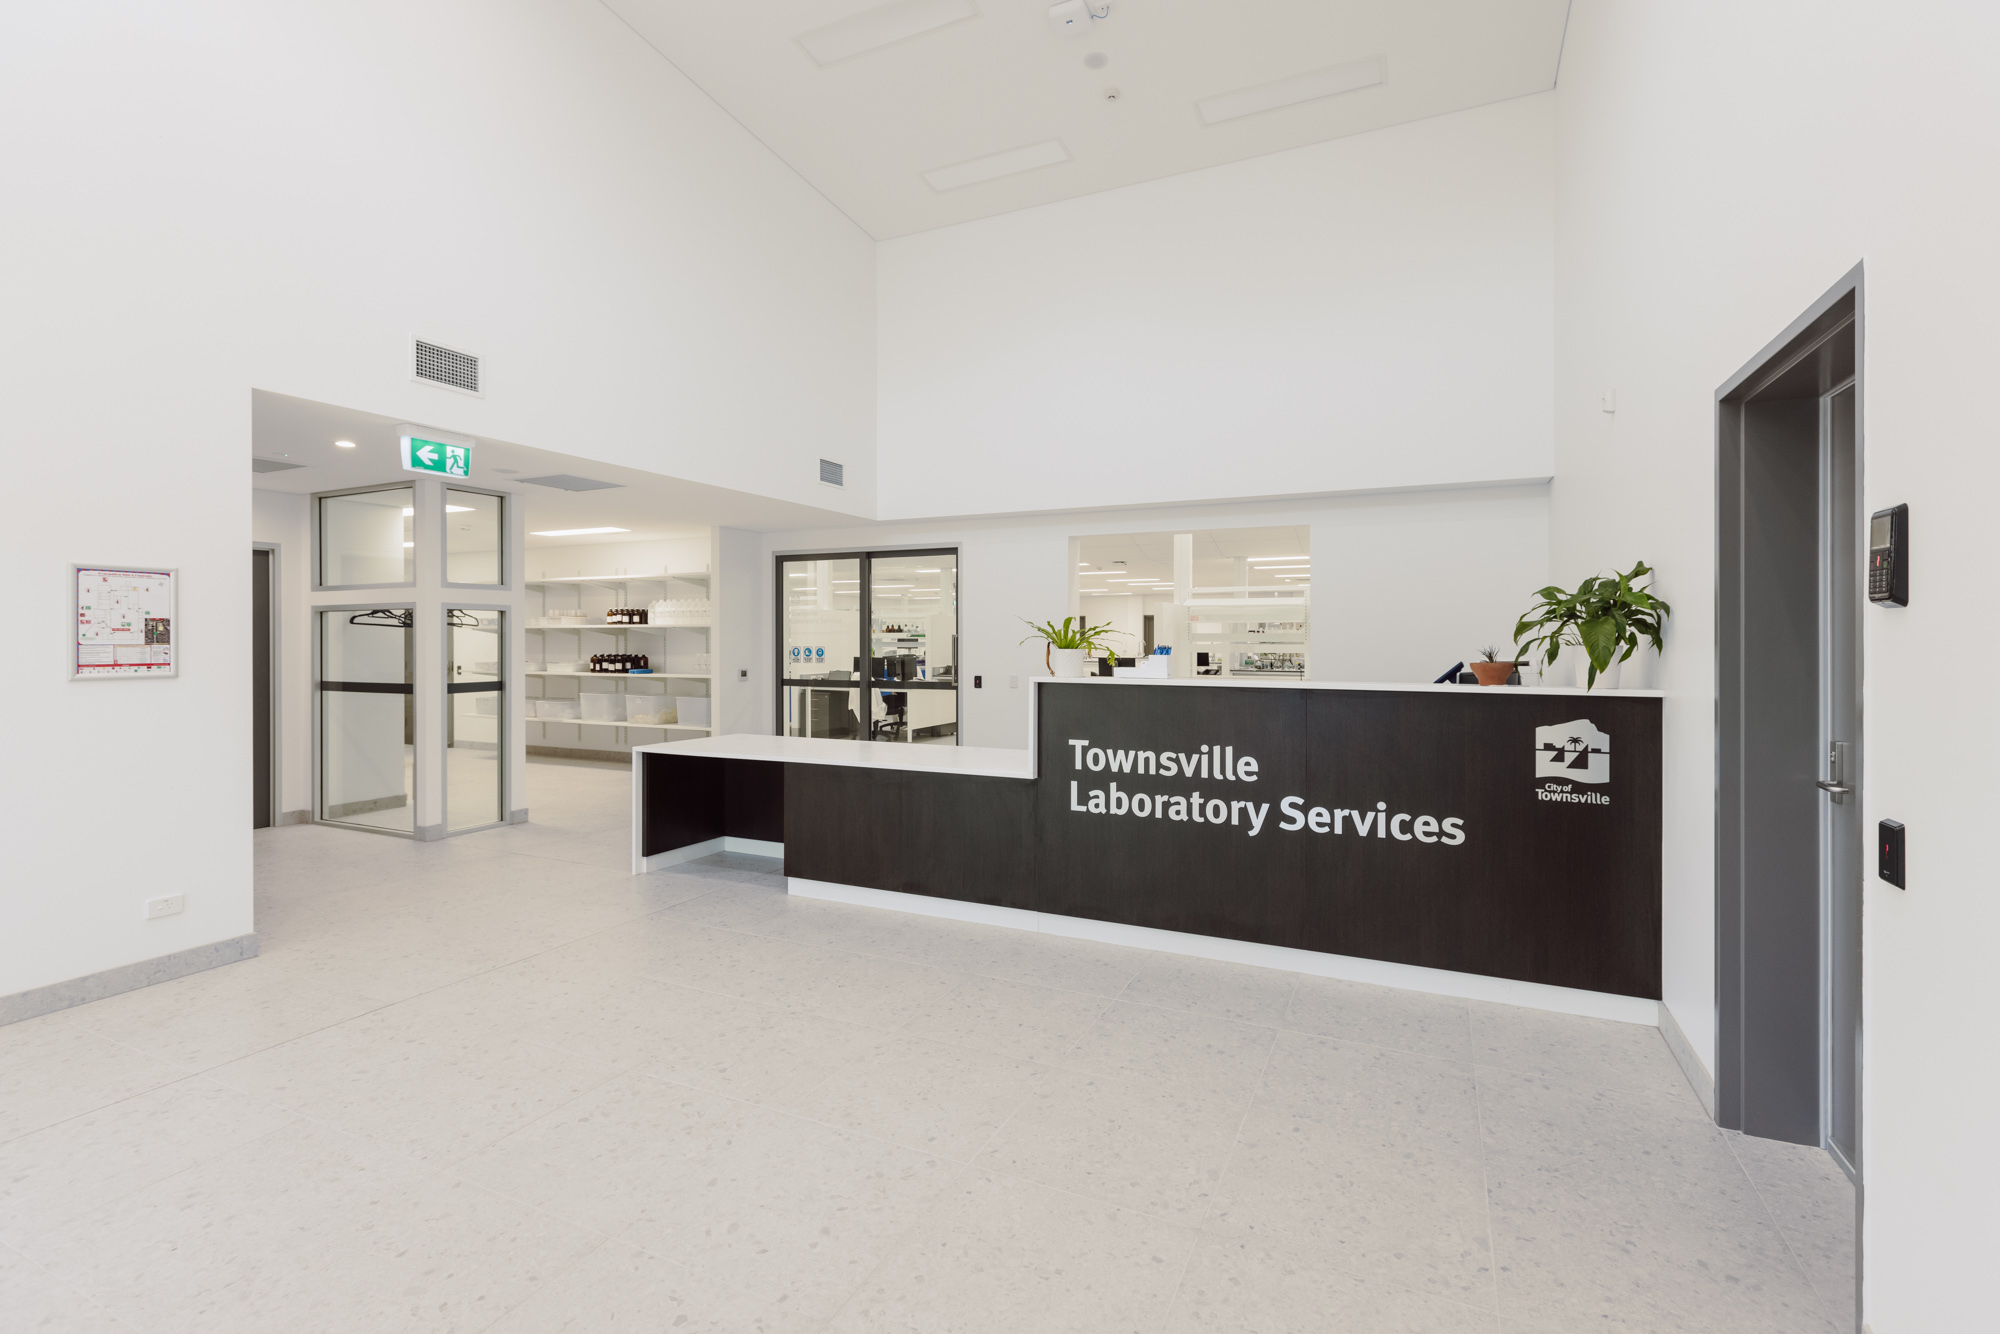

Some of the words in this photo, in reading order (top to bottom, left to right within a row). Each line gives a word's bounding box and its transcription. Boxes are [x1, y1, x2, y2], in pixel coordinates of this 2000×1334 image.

[1068, 738, 1259, 783] Townsville
[1535, 788, 1610, 805] Townsville
[1544, 782, 1562, 793] City
[1562, 784, 1573, 792] of
[1070, 781, 1271, 837] Laboratory
[1278, 795, 1466, 846] Services
